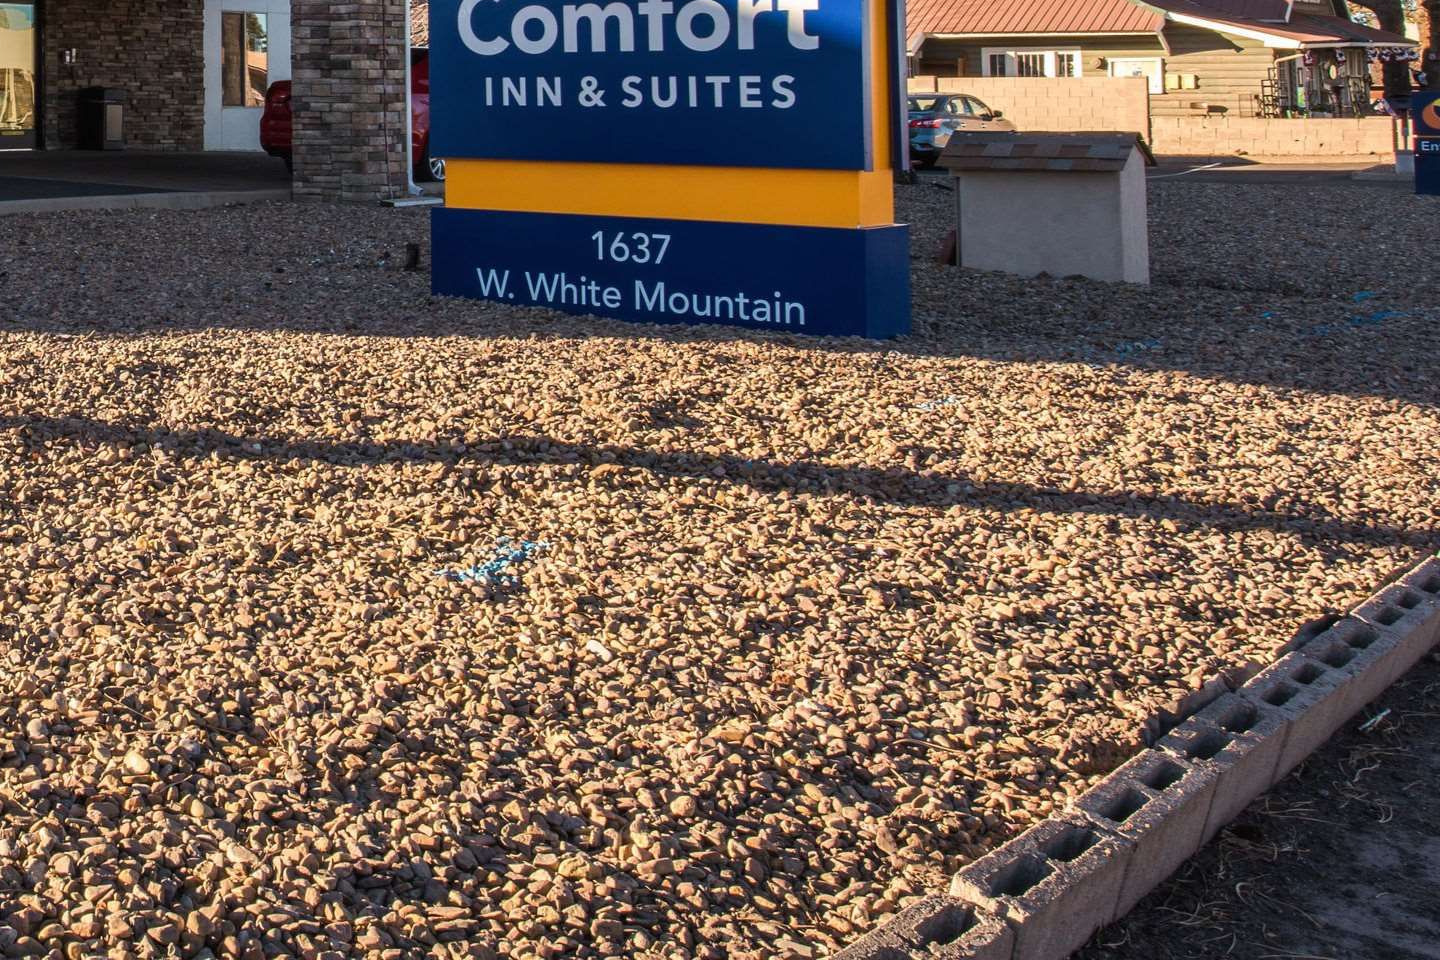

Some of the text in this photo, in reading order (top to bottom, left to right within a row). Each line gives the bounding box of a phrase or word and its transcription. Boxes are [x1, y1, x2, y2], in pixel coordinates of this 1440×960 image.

[485, 74, 797, 108] INN & SUITES
[1421, 140, 1440, 151] En
[591, 230, 672, 265] 1637
[476, 267, 806, 326] W. White Mountain
